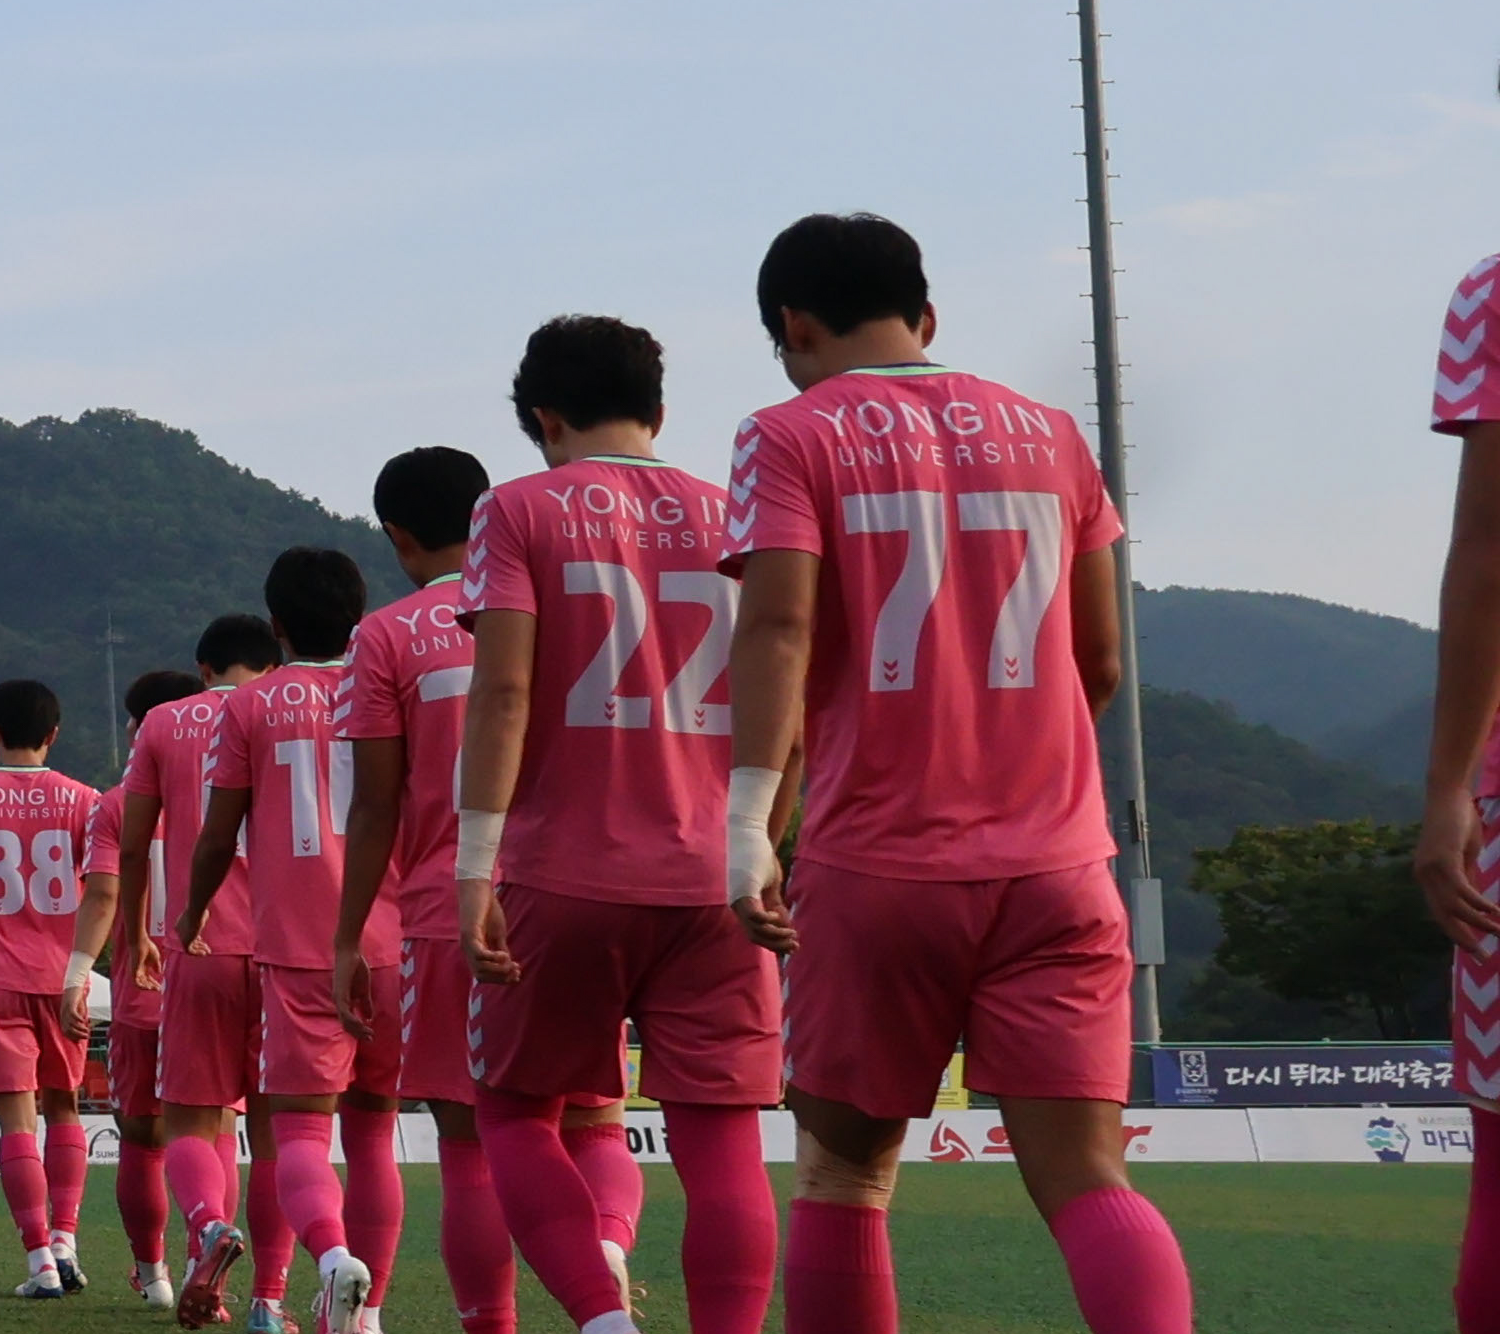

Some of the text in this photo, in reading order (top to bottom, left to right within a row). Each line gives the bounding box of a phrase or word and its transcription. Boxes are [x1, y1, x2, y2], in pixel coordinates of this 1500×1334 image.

[813, 400, 1053, 439] YONG IN
[837, 443, 1057, 468] UNIVERSITY
[545, 484, 685, 525] YONG
[562, 520, 722, 549] UNIVERSI
[841, 489, 1061, 693] 77
[397, 604, 457, 635] YO
[563, 561, 741, 736] 22
[257, 683, 339, 709] YON
[171, 705, 212, 725] YO
[266, 709, 334, 726] UNIVE
[53, 787, 76, 805] IN
[1225, 1065, 1280, 1087] 다시
